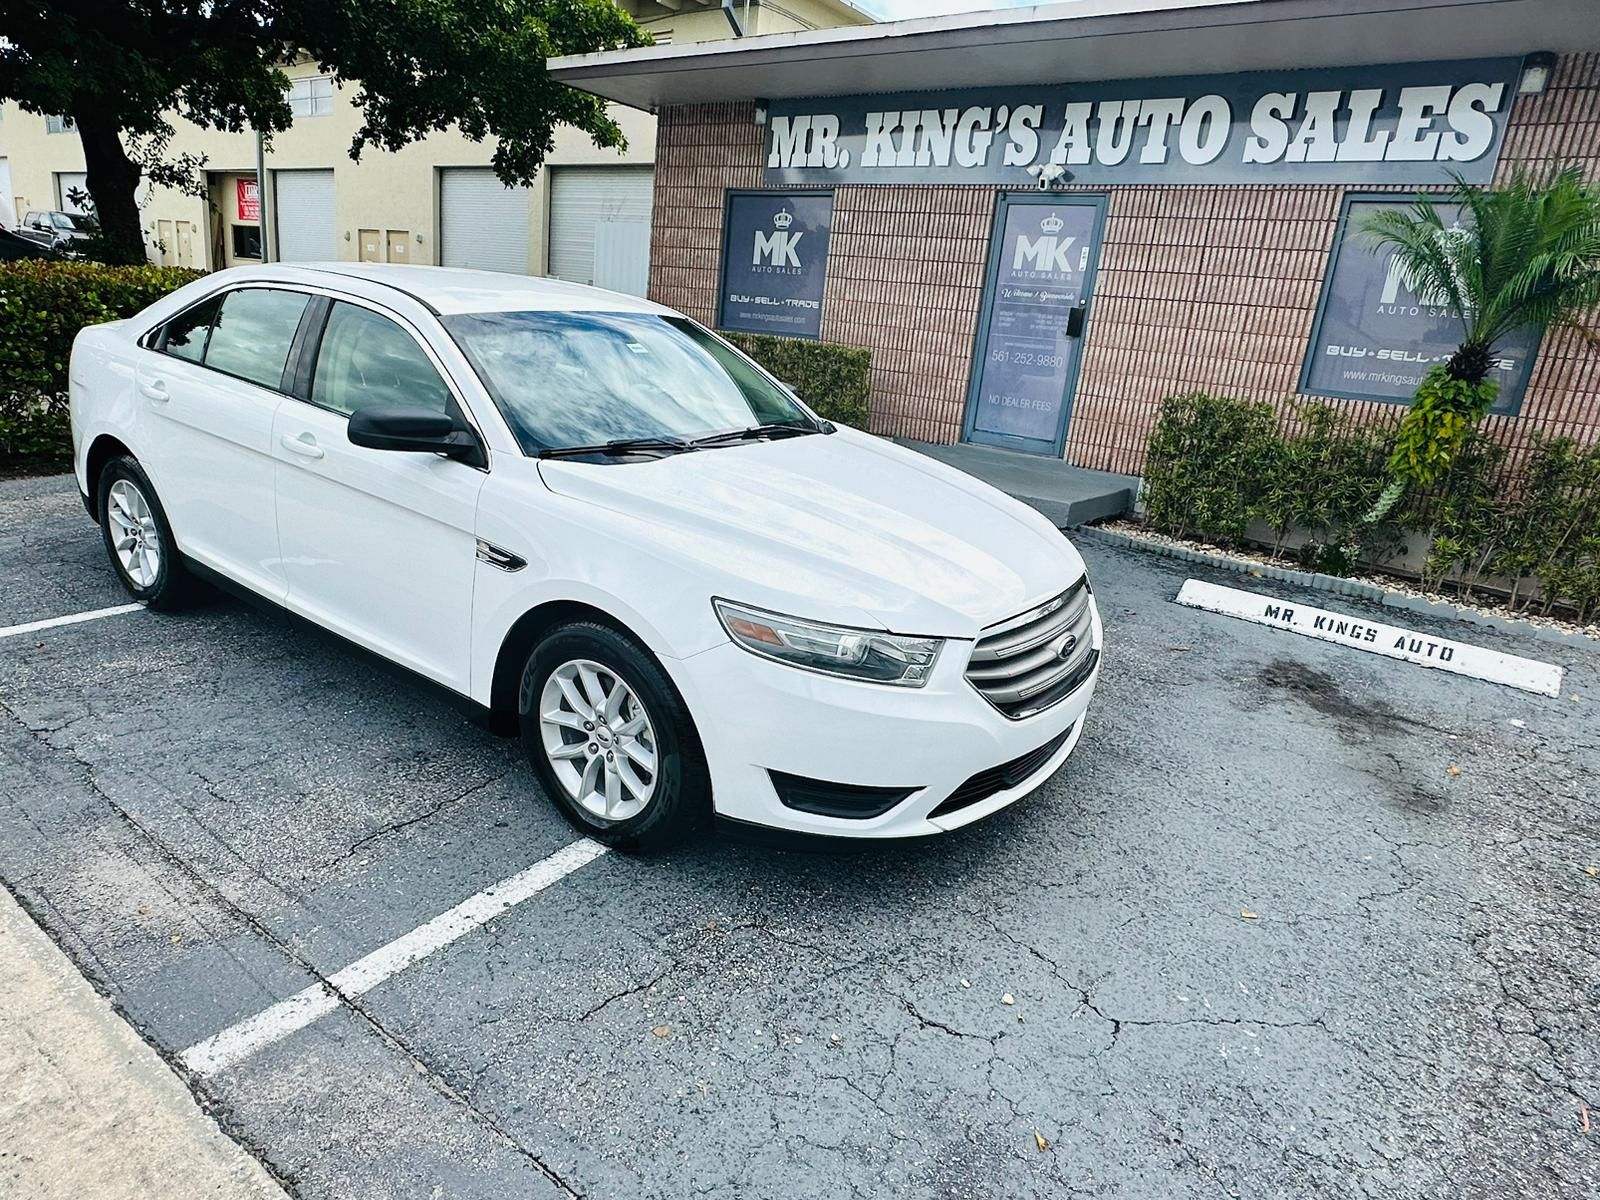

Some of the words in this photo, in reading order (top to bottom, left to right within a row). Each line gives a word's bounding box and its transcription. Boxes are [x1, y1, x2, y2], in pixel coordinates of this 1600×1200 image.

[768, 115, 849, 168] MR.
[861, 104, 1043, 168] KING'S
[1051, 94, 1231, 166] AUTO
[1243, 83, 1504, 163] SALES
[753, 231, 804, 267] MK
[1013, 235, 1076, 272] MK
[751, 266, 772, 274] AUTO
[776, 266, 802, 275] SALES
[1011, 271, 1036, 279] AUTO
[1041, 272, 1072, 280] SALES
[730, 294, 750, 303] BUY
[754, 296, 780, 306] SELL
[785, 298, 819, 309] TRADE
[1376, 305, 1419, 316] AUTO
[991, 349, 1063, 368] 561-252-9880
[1326, 345, 1367, 358] BUY
[1376, 349, 1430, 363] SELL
[1343, 369, 1425, 387] www.mrkingsaut
[988, 393, 1000, 405] NO
[1001, 396, 1031, 410] DEALER
[1031, 399, 1052, 412] FEES
[1265, 604, 1299, 625] MR.
[1313, 614, 1378, 643] KINGS
[1394, 637, 1455, 662] AUTO
